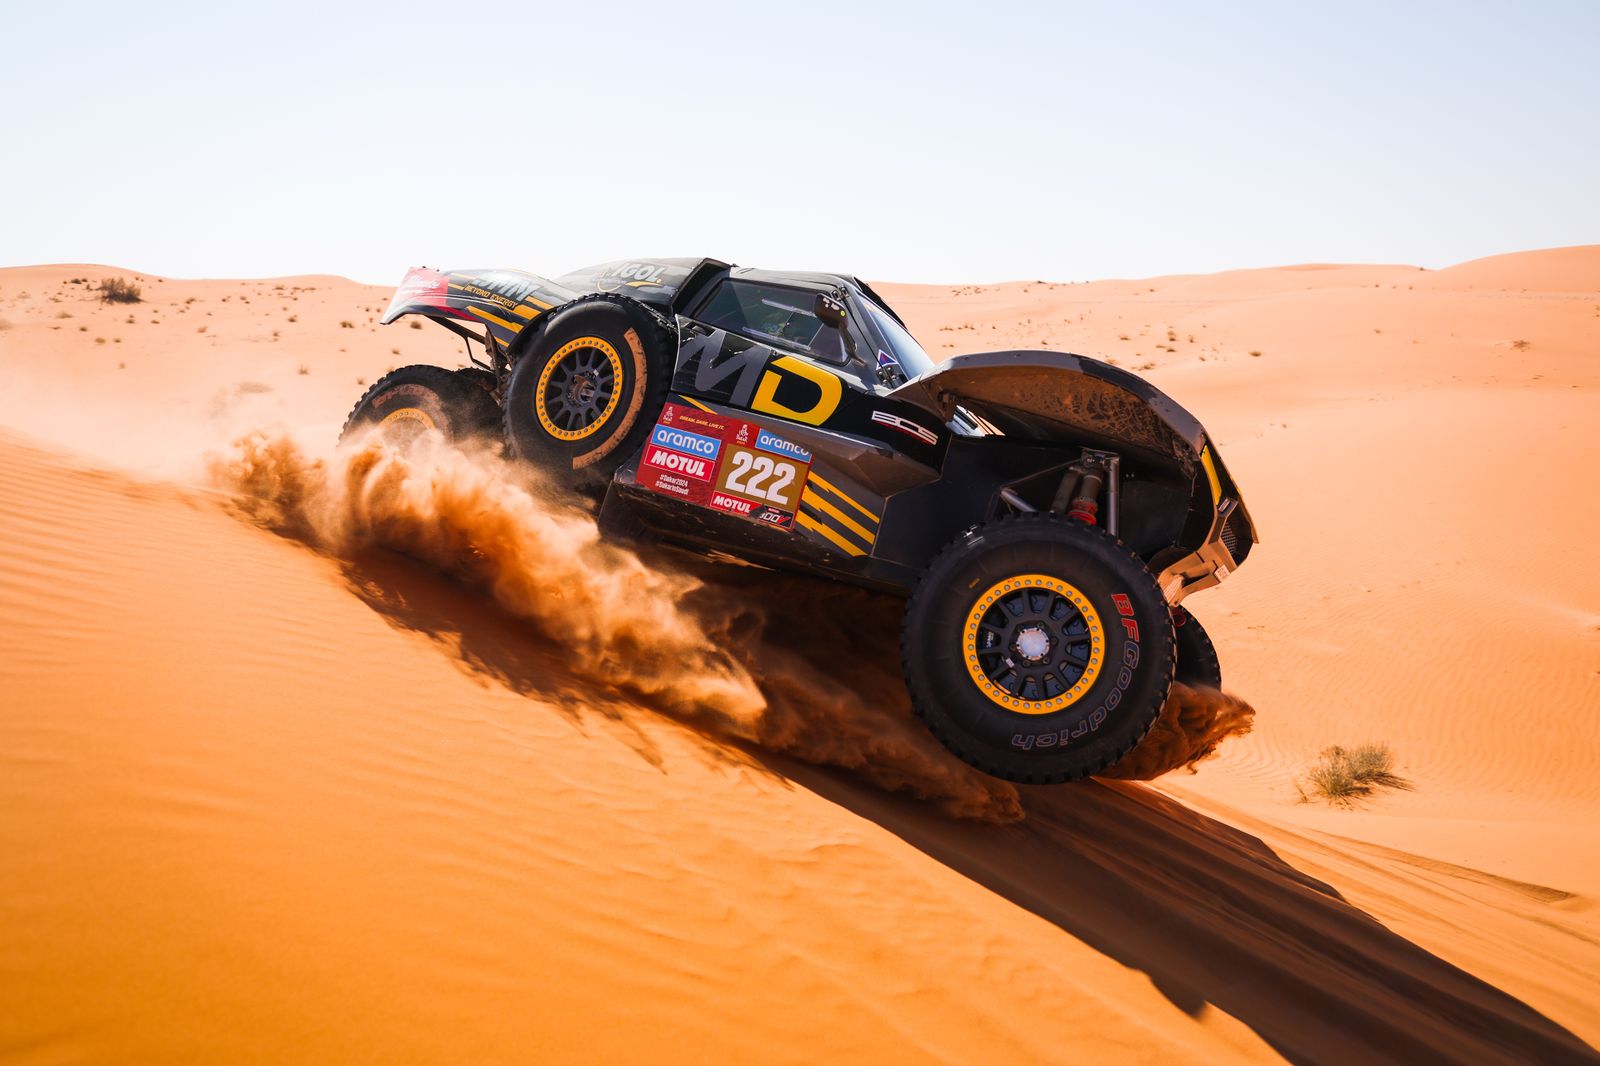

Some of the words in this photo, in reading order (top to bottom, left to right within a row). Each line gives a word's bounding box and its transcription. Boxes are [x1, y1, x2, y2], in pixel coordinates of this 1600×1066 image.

[611, 263, 668, 281] IGOL
[464, 285, 491, 299] BEYOND
[491, 293, 519, 310] ENERGY
[657, 429, 714, 454] aramco
[650, 450, 706, 477] MOTUL
[725, 451, 796, 505] 222
[713, 495, 751, 513] MOTUL
[1011, 593, 1140, 750] BFGoodrich
